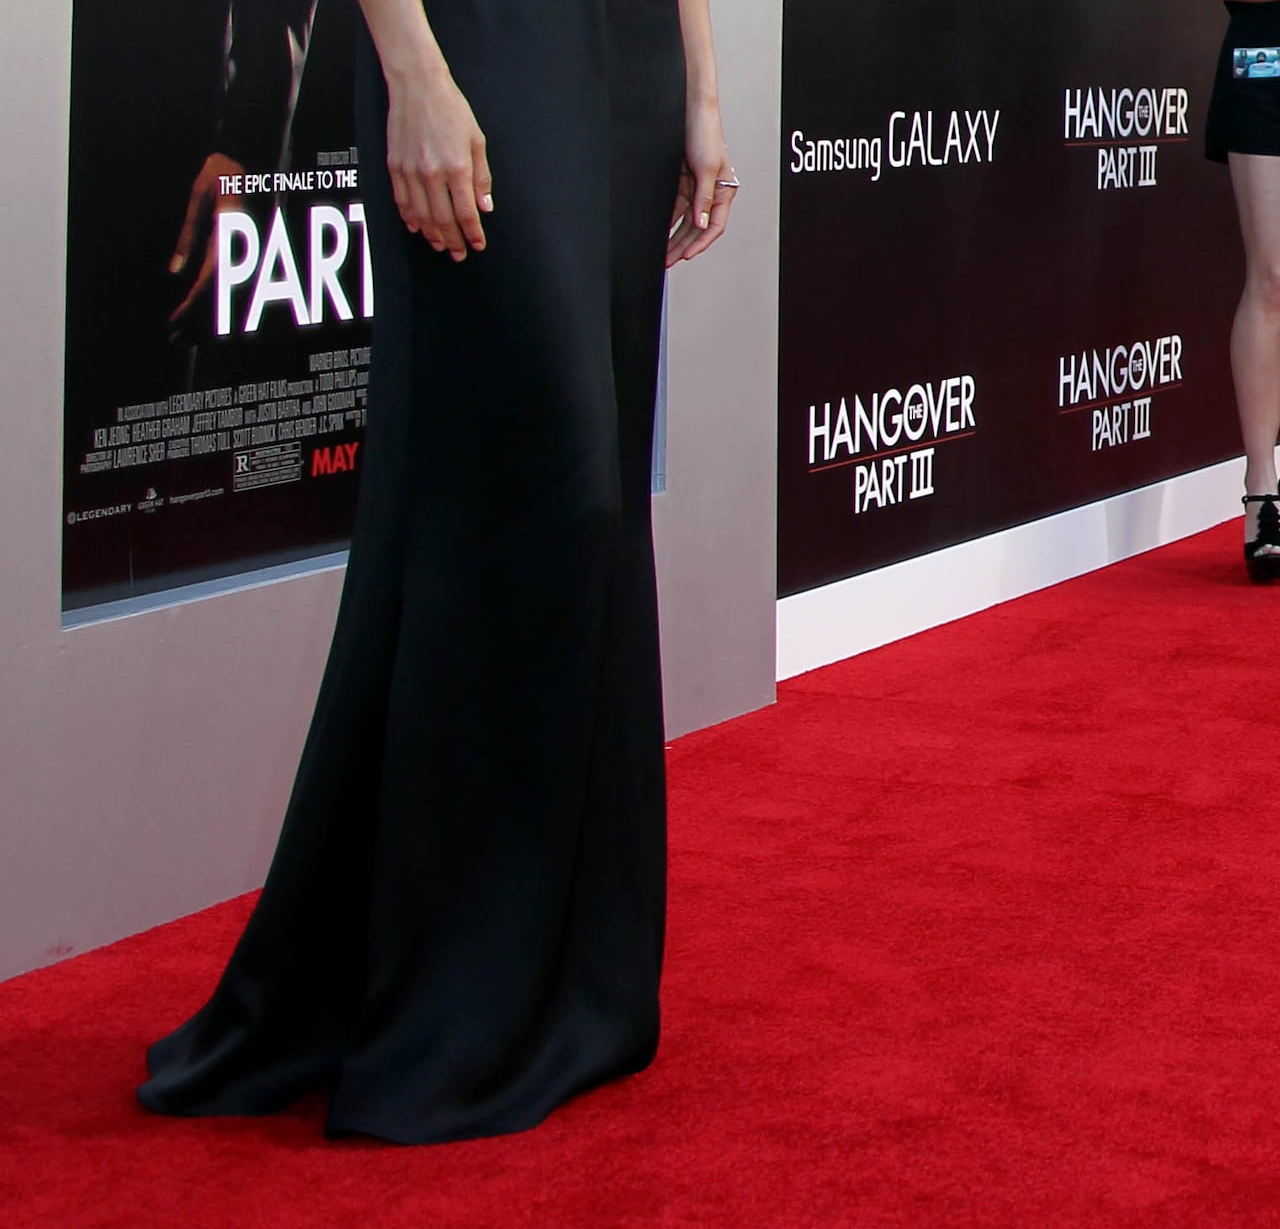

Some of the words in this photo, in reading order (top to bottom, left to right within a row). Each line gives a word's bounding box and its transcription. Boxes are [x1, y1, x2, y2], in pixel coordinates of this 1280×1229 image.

[1064, 88, 1188, 139] HANGOVER
[790, 130, 882, 182] Samsung
[888, 110, 1000, 168] GALAXY
[1098, 147, 1138, 190] PART
[1138, 146, 1158, 187] III
[219, 176, 242, 195] THE
[245, 173, 271, 193] EPIC
[274, 172, 314, 191] FINALE
[316, 171, 333, 188] TO
[335, 169, 357, 188] THE
[217, 203, 374, 336] PART
[1060, 335, 1183, 407] HANGOVER
[809, 376, 976, 464] HANGOVER
[908, 402, 922, 421] THE
[1092, 403, 1132, 452] PART
[1132, 397, 1152, 440] III
[237, 455, 248, 472] R
[312, 442, 359, 477] MAY
[855, 453, 909, 514] PART
[908, 448, 935, 500] III
[77, 503, 132, 521] LEGENDARY
